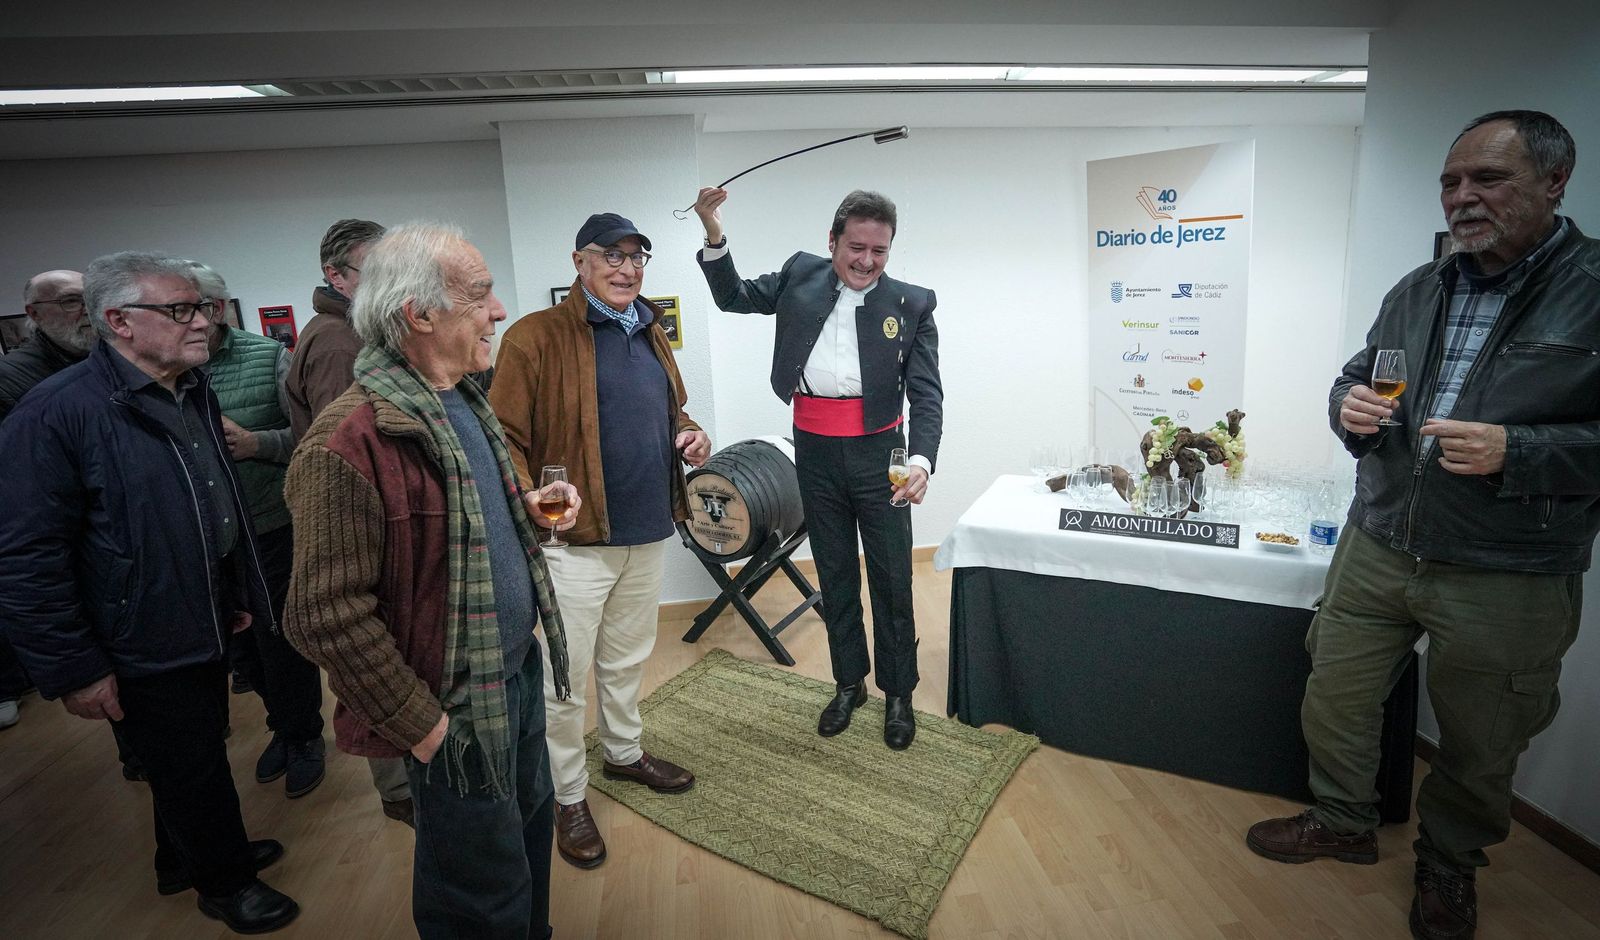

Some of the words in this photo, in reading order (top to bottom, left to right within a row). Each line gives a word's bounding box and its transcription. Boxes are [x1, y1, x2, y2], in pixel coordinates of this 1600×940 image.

[1158, 189, 1177, 203] 40
[1096, 229, 1146, 247] Diario
[1150, 224, 1173, 244] de
[1176, 225, 1225, 248] Jerez
[1195, 283, 1228, 292] Diputación
[1122, 320, 1159, 329] Verinsur
[1090, 514, 1213, 538] AMONTILLADO
